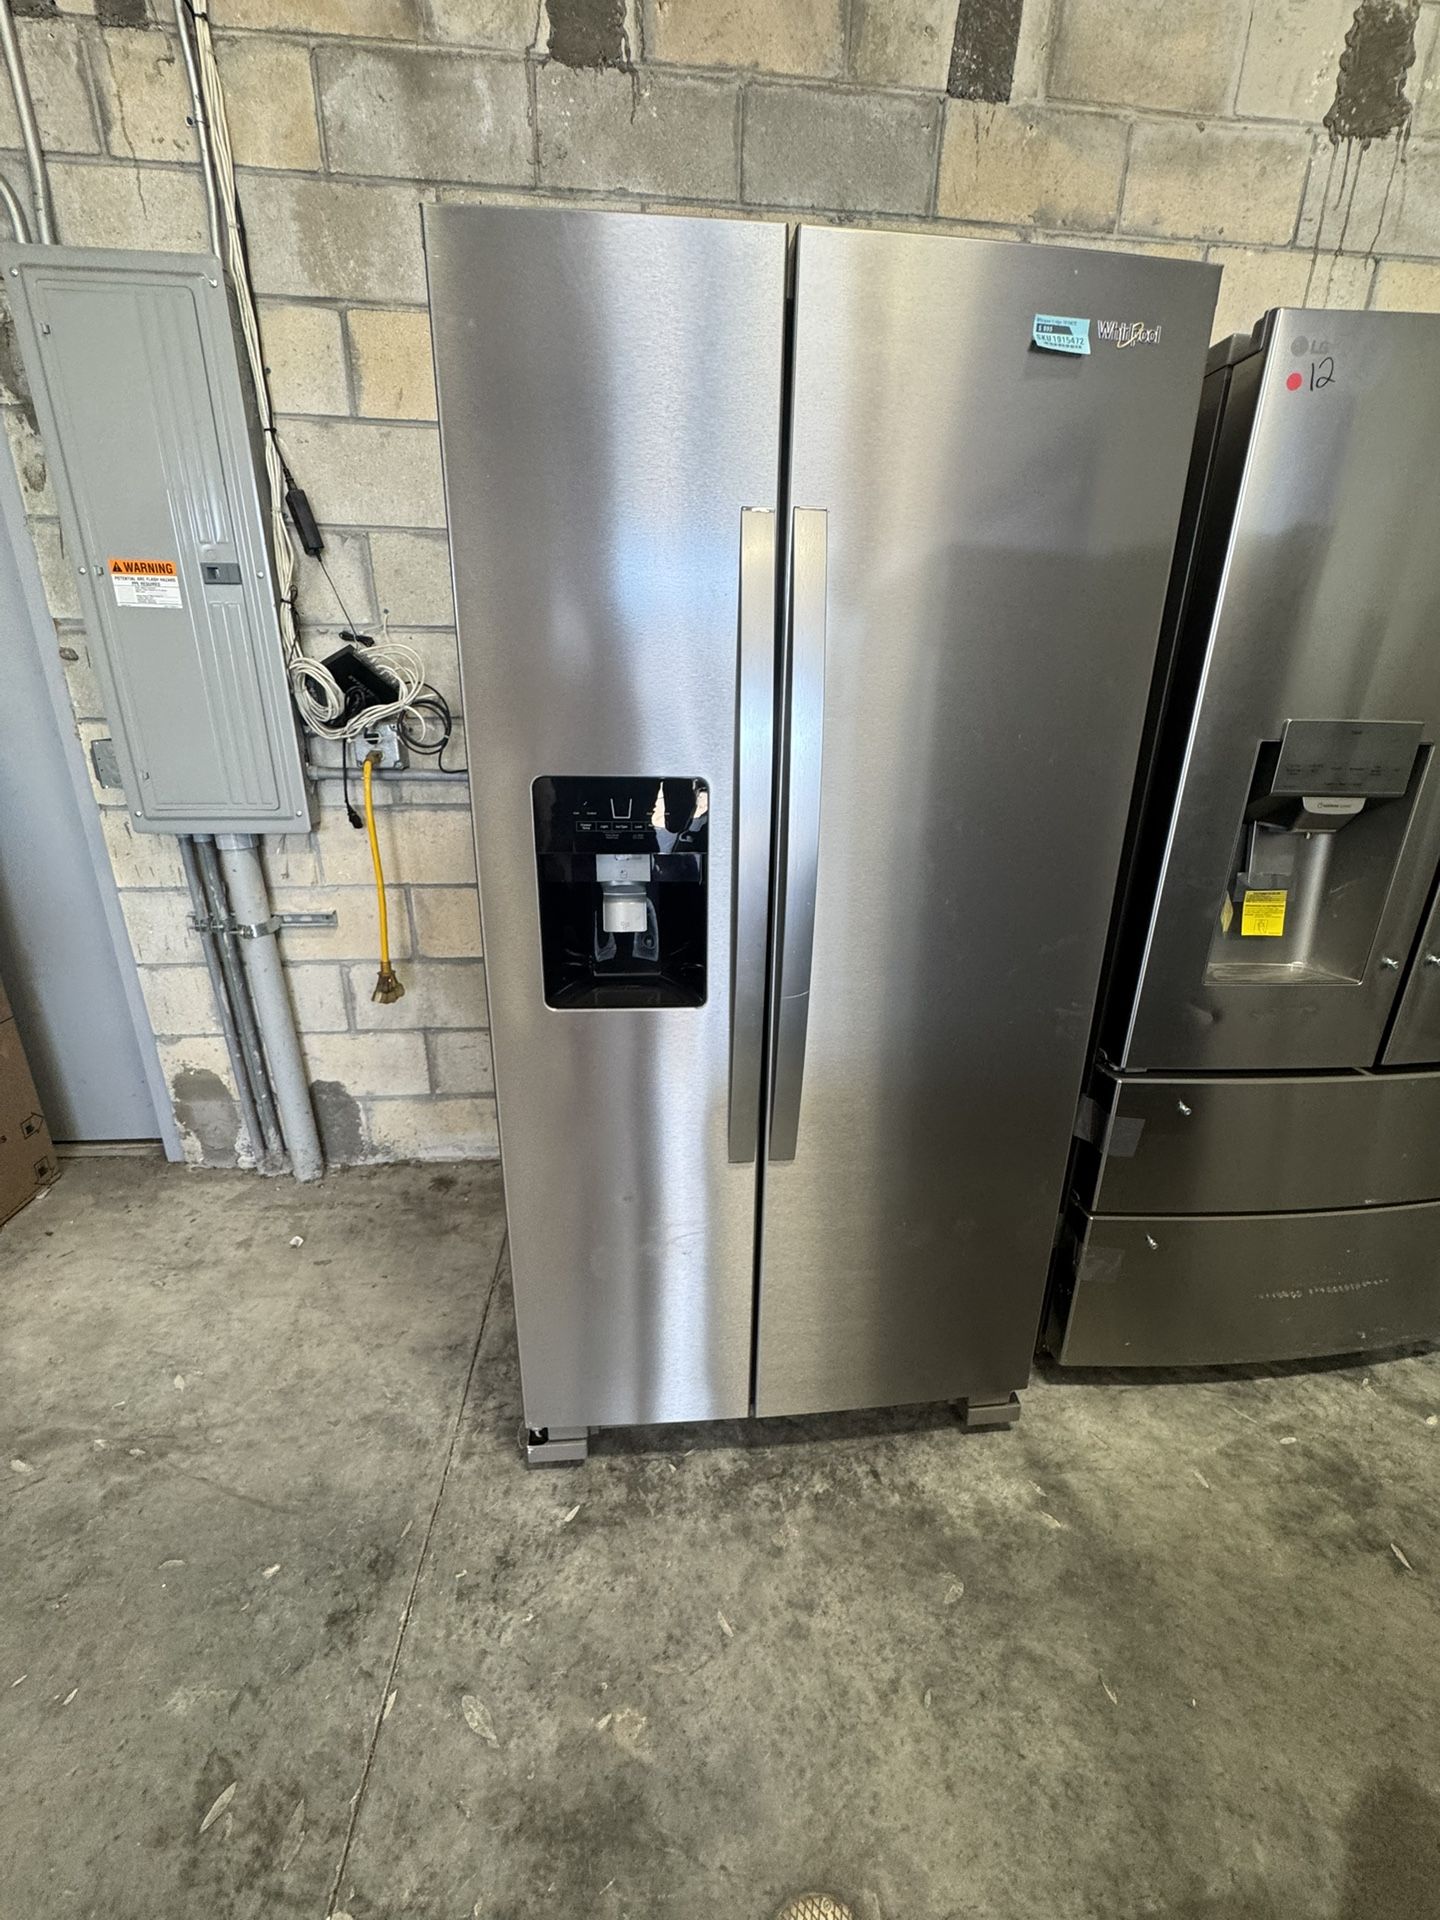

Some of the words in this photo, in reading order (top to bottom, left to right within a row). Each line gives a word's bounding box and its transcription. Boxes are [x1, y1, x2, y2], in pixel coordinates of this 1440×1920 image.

[1097, 319, 1162, 348] Whirlpool
[1310, 340, 1329, 354] LG
[1310, 356, 1336, 391] 12
[123, 561, 173, 574] WARNING
